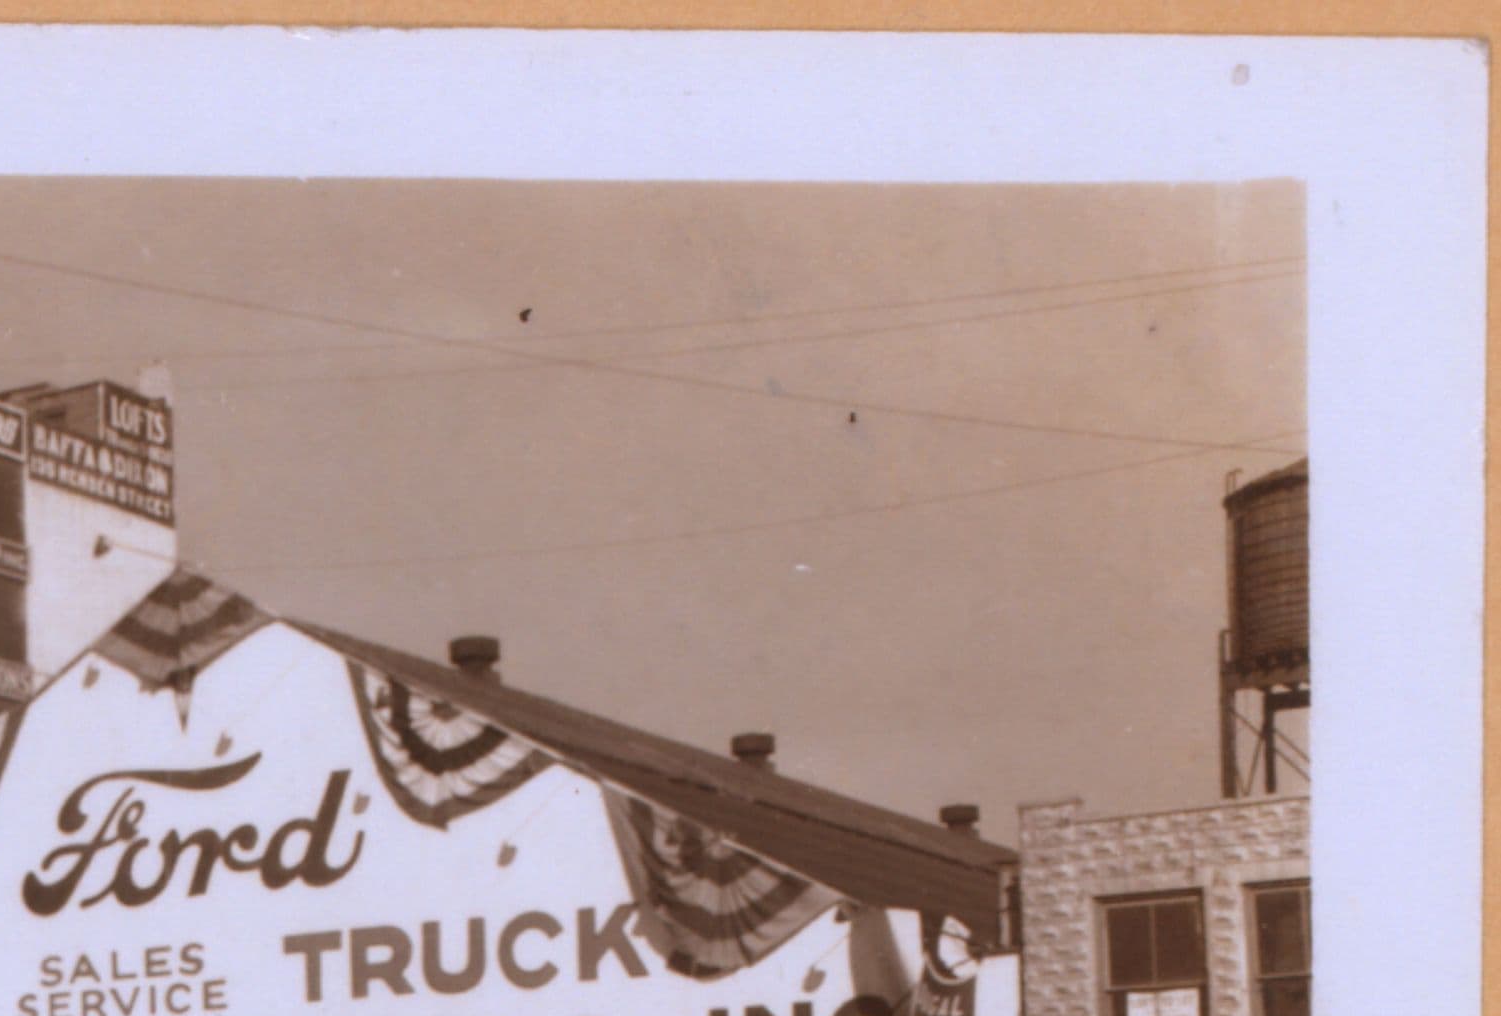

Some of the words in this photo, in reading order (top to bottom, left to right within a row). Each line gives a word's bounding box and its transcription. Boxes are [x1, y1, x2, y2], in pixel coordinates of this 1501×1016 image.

[109, 395, 167, 445] LOFTS
[22, 751, 365, 917] Ford
[39, 942, 206, 987] SALES
[281, 903, 650, 1003] TRUCK
